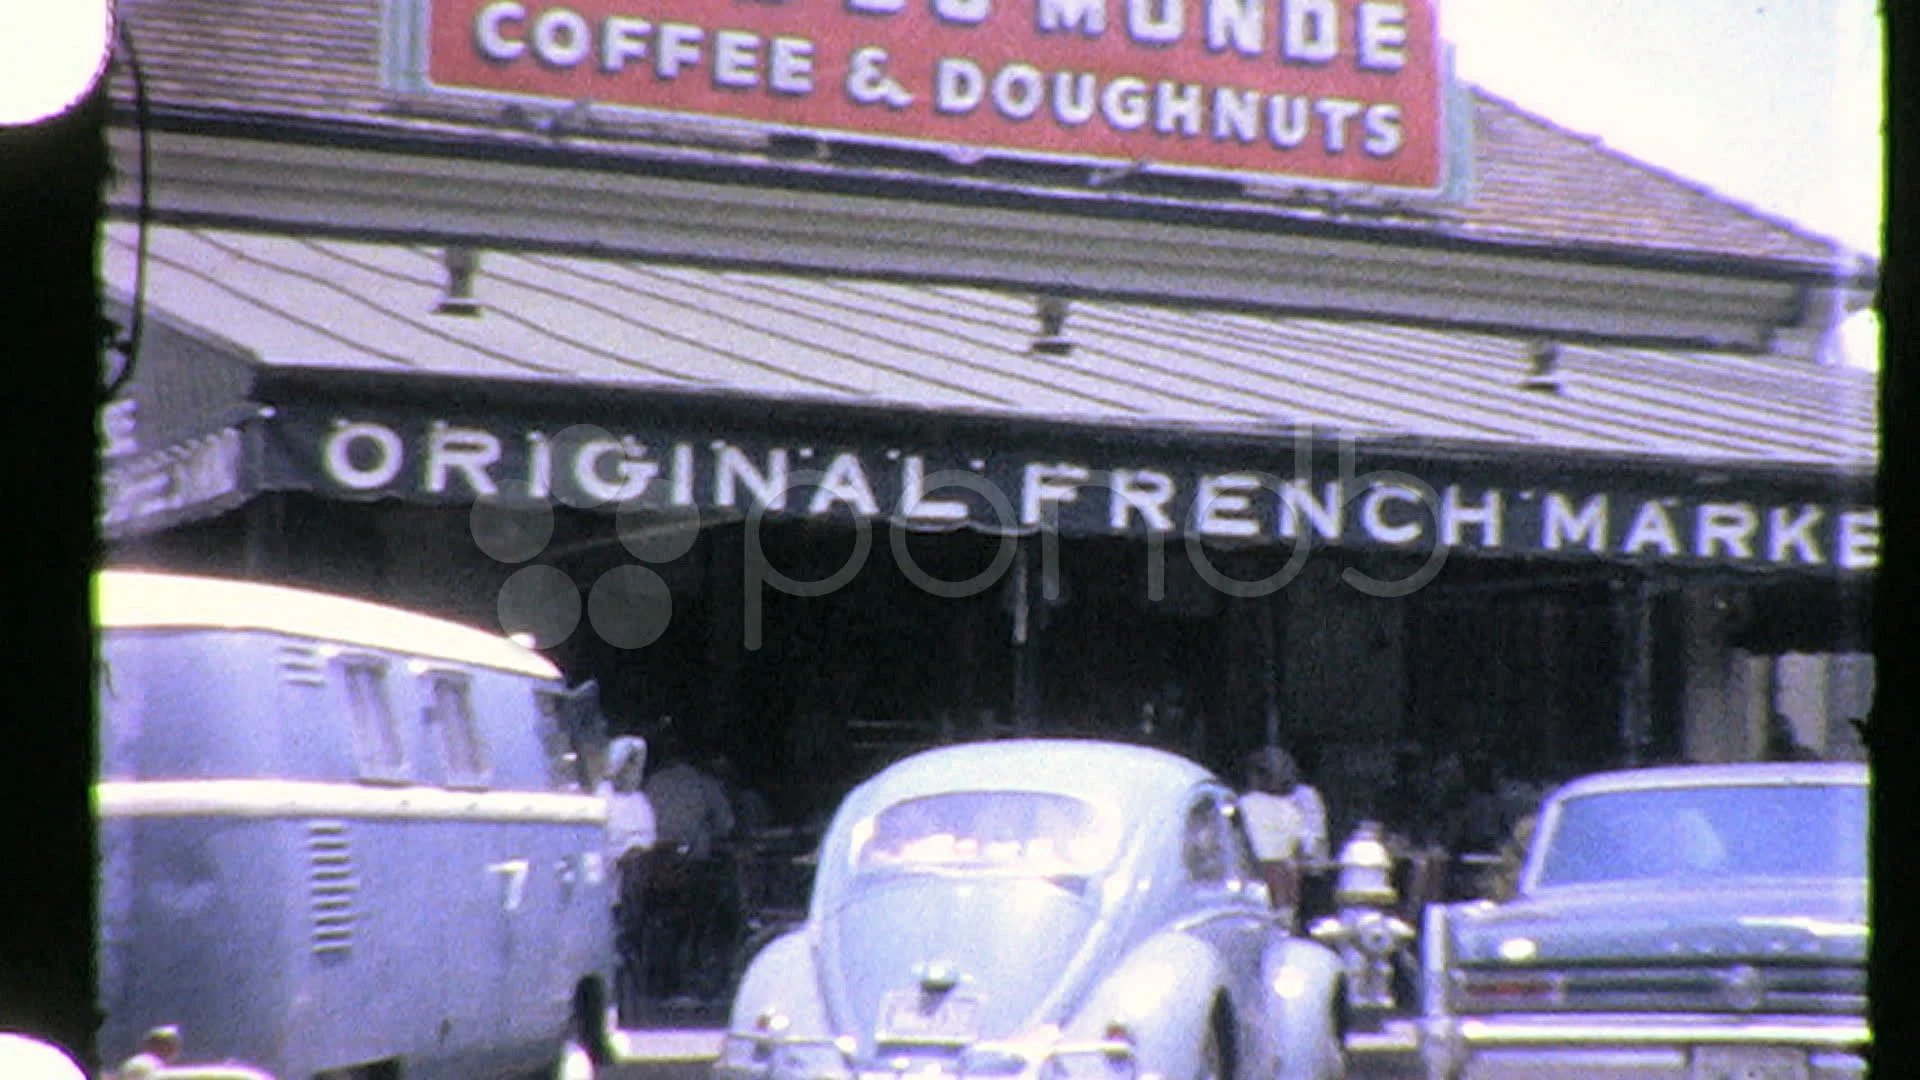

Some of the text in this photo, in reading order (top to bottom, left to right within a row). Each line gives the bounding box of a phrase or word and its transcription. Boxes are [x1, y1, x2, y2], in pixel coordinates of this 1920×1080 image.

[475, 1, 1405, 157] COFFEE & DOUGHNUTS
[324, 419, 970, 521] ORIGINAL
[1020, 461, 1503, 547] FRENCH
[1541, 490, 1881, 569] MARKE
